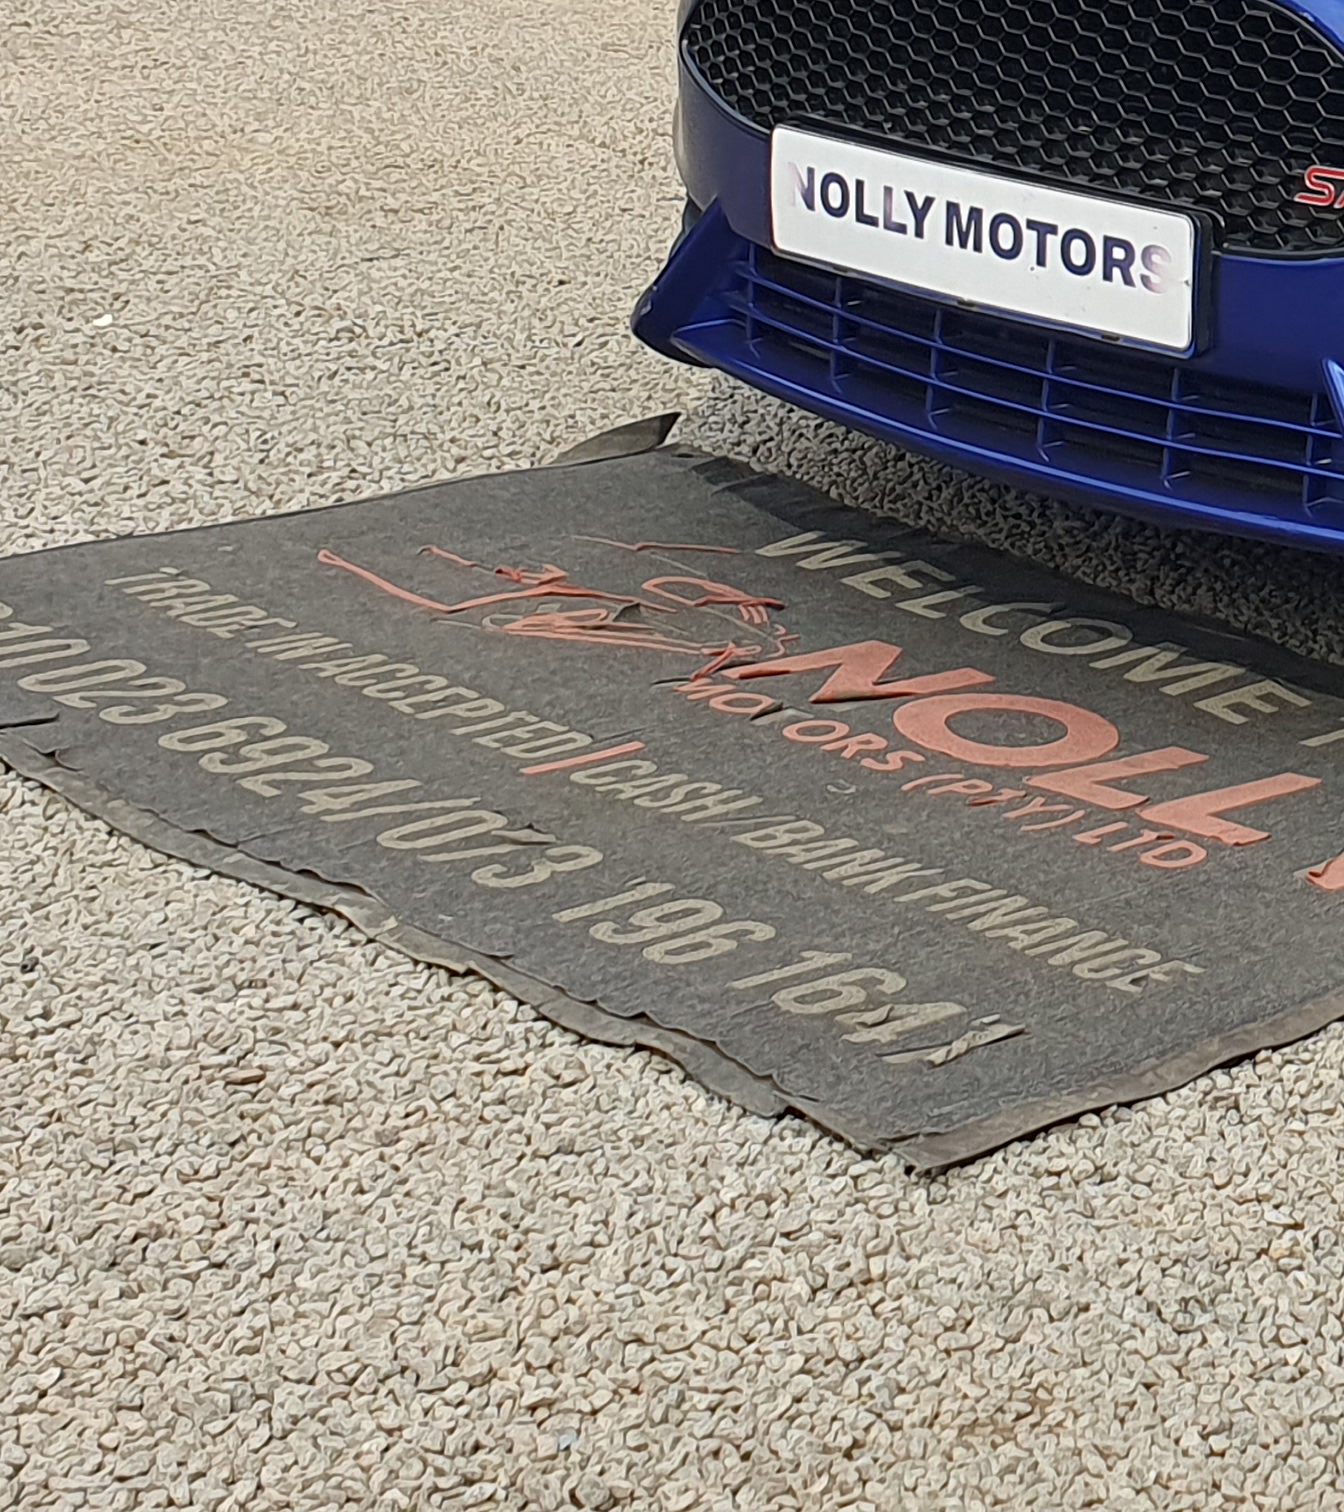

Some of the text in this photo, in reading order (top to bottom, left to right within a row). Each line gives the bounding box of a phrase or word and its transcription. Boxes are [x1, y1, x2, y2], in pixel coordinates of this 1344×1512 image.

[788, 161, 1172, 295] NOLLY MOTORS
[0, 600, 92, 669] 10
[755, 530, 1311, 725] WELCOME
[17, 658, 230, 725] 023
[1072, 821, 1208, 868] LTD
[551, 876, 777, 966] 196
[893, 877, 1207, 993] FINANCE
